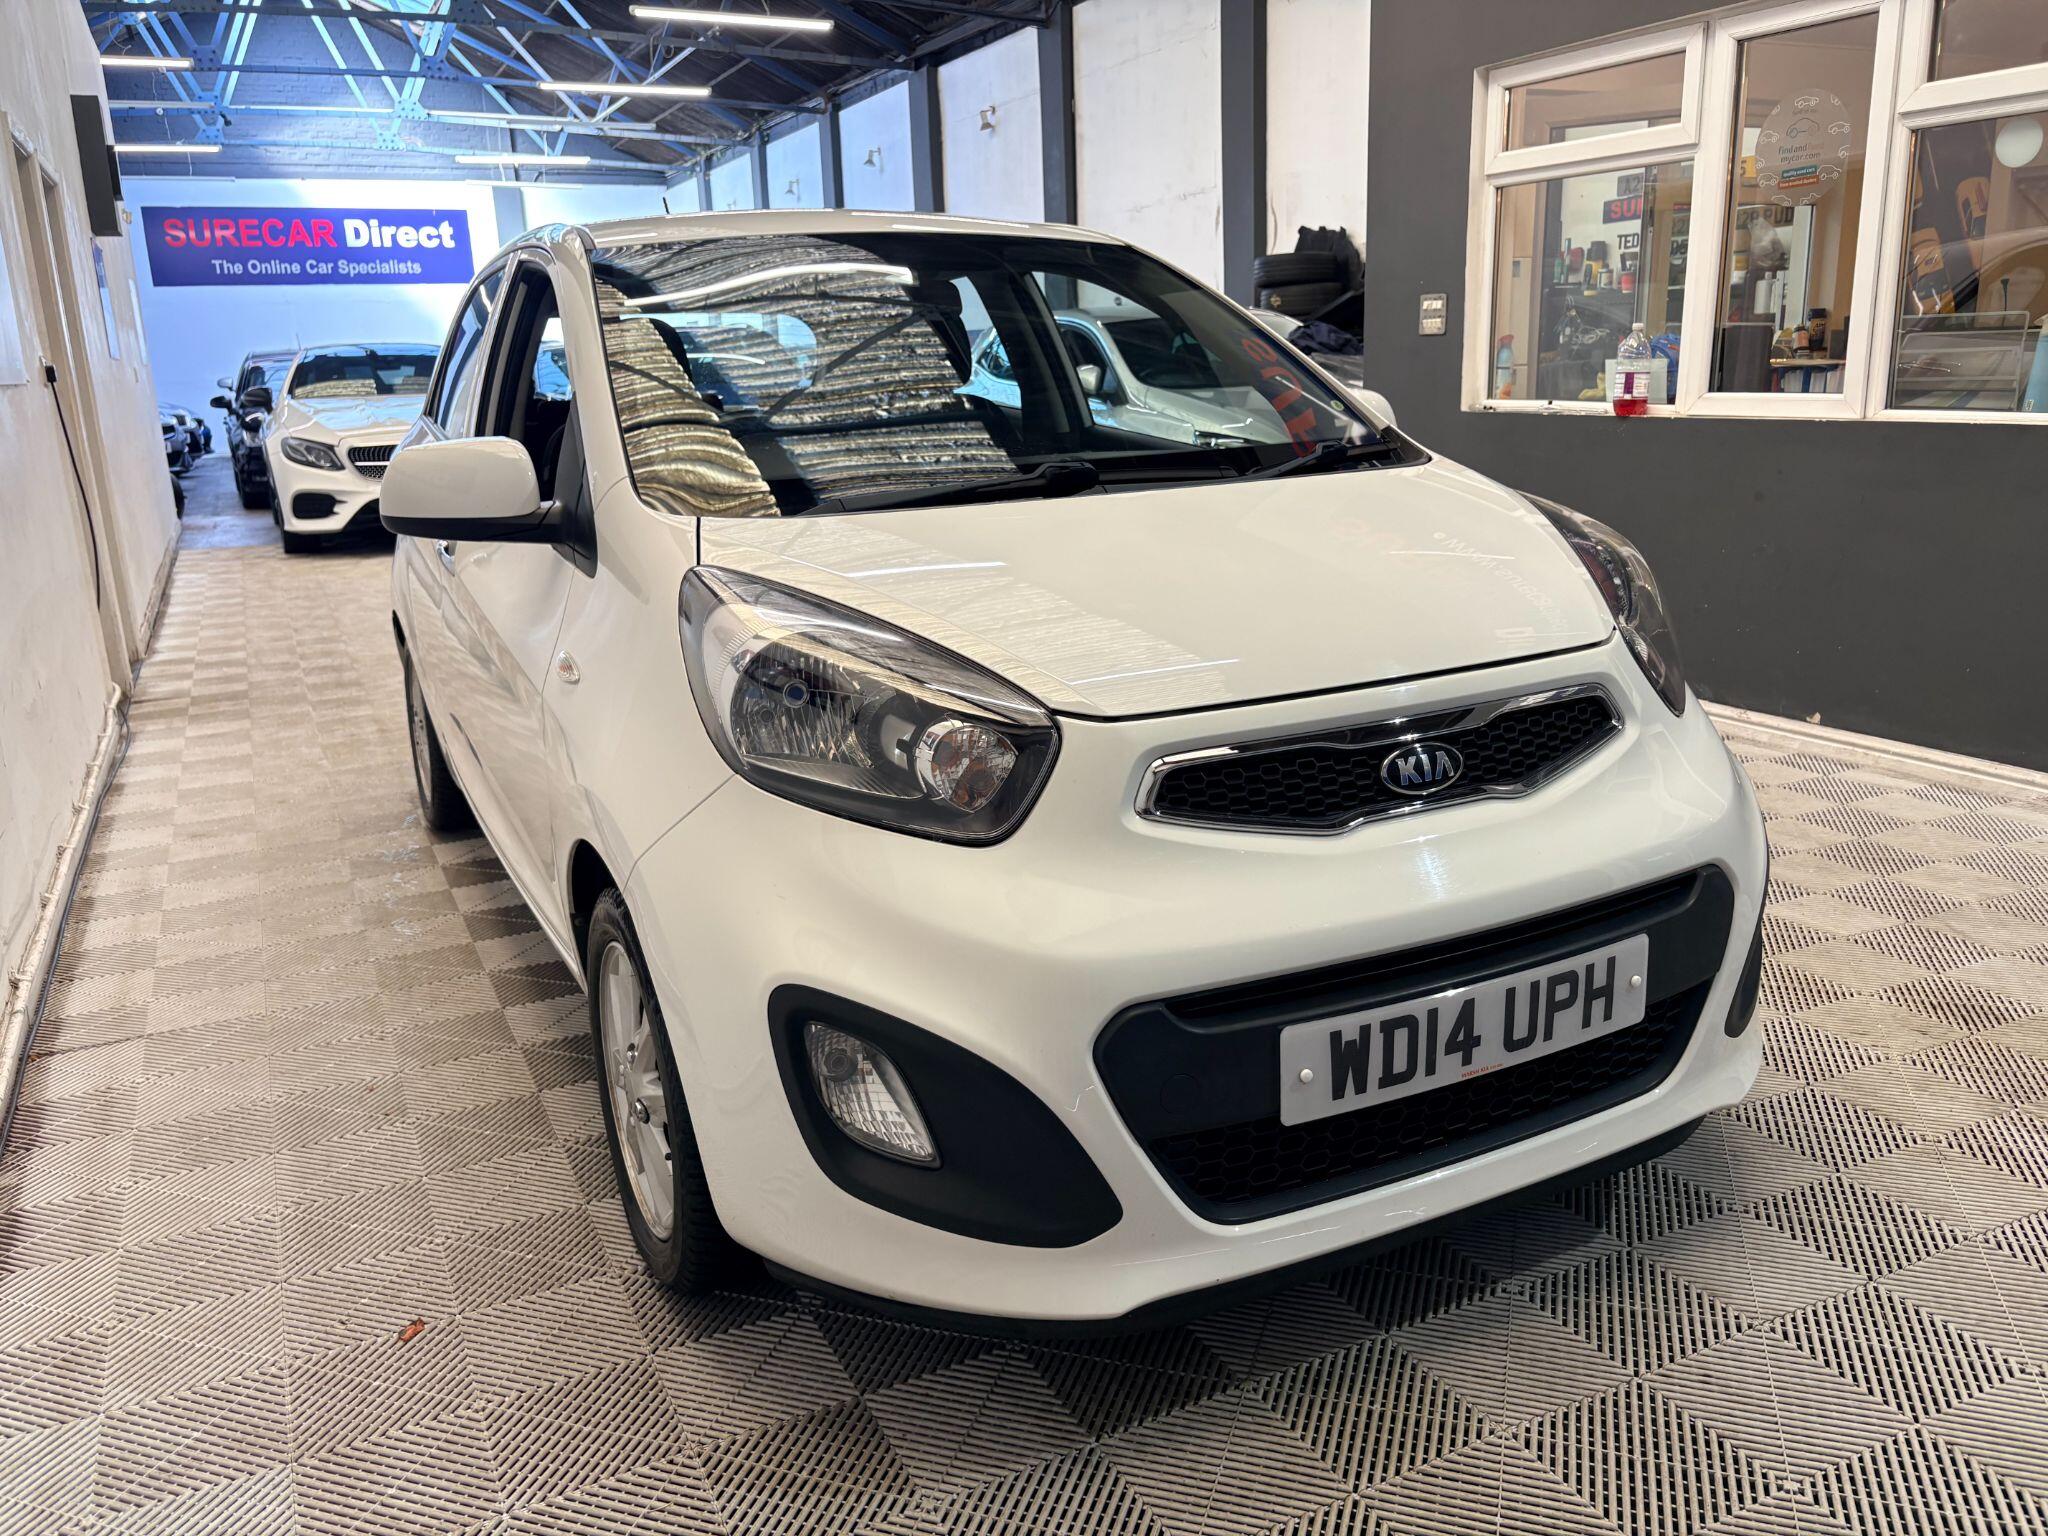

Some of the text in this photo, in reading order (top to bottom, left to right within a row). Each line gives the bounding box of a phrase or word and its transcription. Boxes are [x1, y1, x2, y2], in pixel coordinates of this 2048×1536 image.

[163, 218, 455, 248] SURECAR Direct
[211, 259, 422, 277] The Online Car Specialists
[1395, 751, 1455, 785] KIA
[1329, 955, 1616, 1101] WD14 UPH
